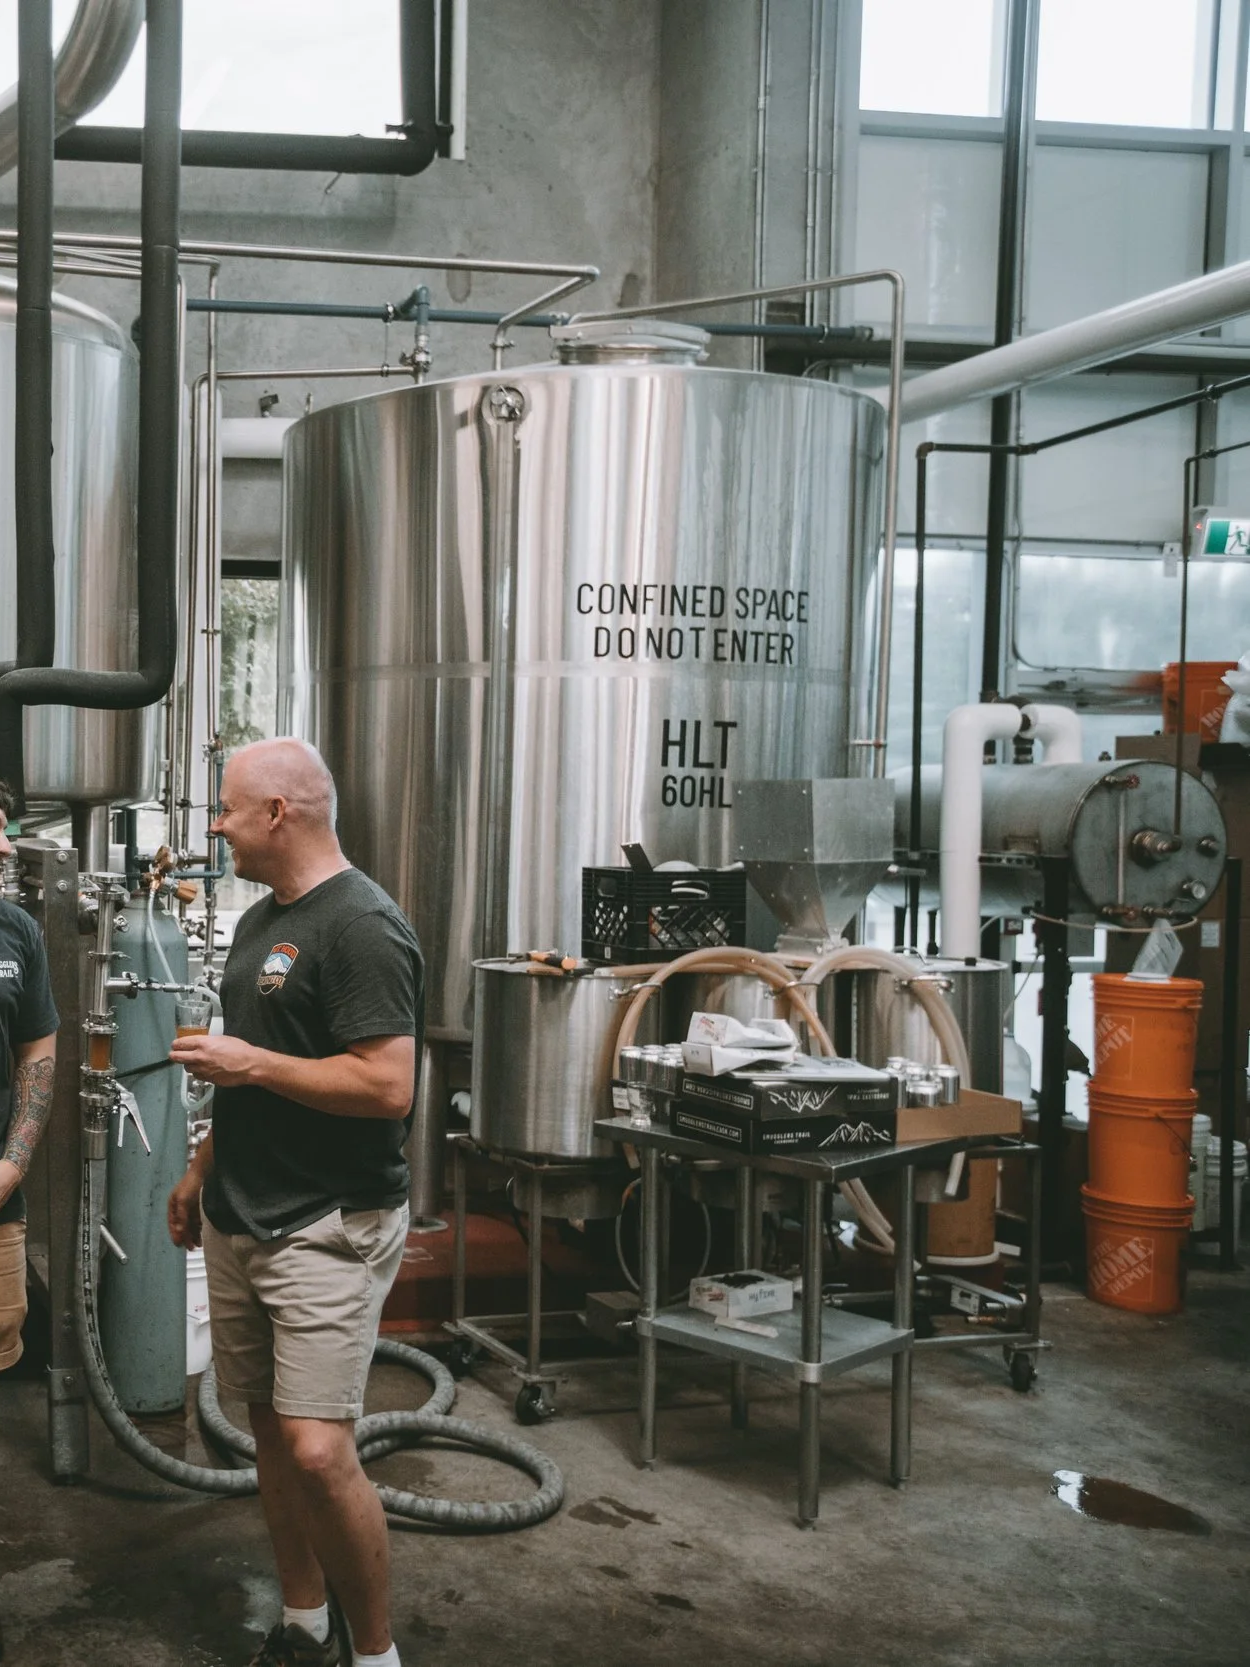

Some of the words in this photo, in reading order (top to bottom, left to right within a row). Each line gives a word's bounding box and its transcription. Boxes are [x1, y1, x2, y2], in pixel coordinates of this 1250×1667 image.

[577, 583, 725, 618] CONFINED
[735, 587, 809, 623] SPACE
[594, 627, 635, 658] DO
[646, 627, 706, 659] NOT
[713, 628, 794, 664] ENTER
[661, 719, 737, 769] HLT
[661, 775, 732, 808] 60HL
[1090, 1236, 1154, 1291] HOME
[1108, 1260, 1152, 1295] DEPOT
